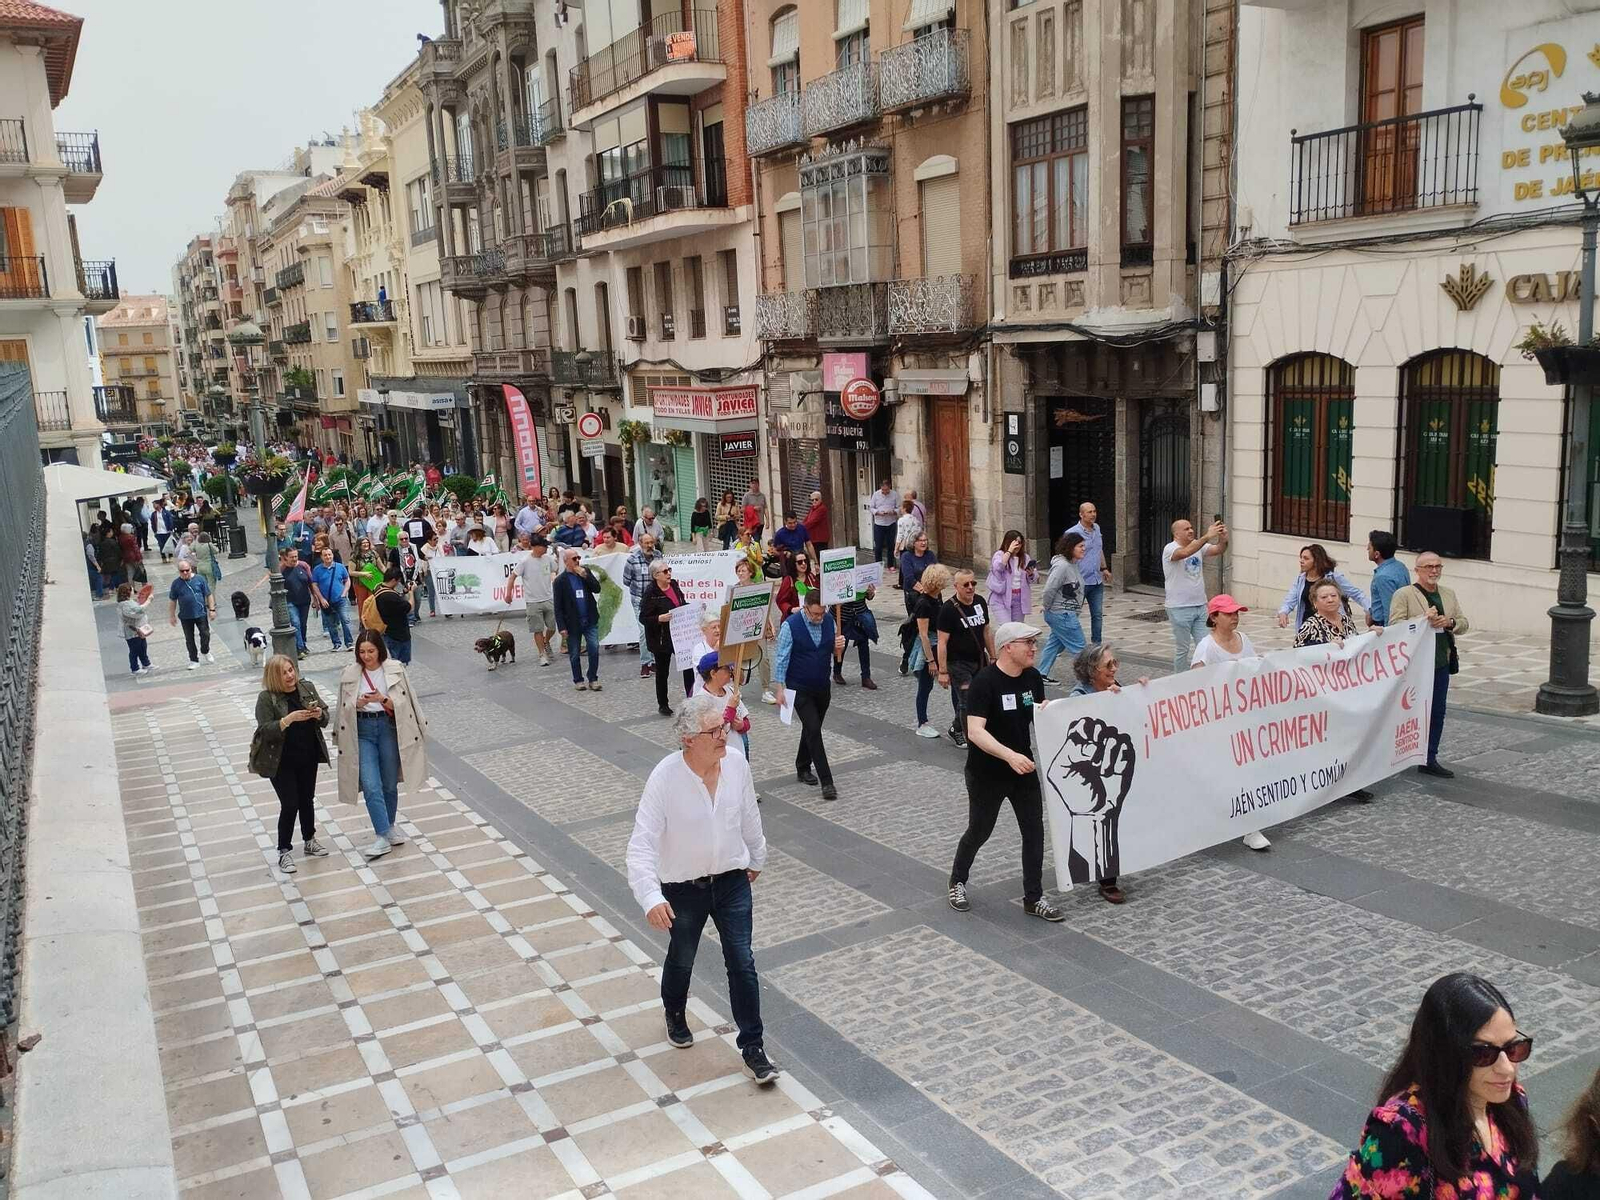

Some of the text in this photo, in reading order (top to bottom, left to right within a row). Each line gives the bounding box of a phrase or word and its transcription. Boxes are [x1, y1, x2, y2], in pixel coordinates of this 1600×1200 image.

[1502, 148, 1531, 169] DE
[1515, 180, 1543, 201] DE
[716, 391, 754, 401] OPORTUNIDADES
[848, 393, 877, 402] Mahou
[692, 395, 713, 417] JAVIER
[717, 399, 755, 411] JAVIER
[724, 440, 753, 450] JAVIER
[504, 563, 517, 578] DE
[698, 580, 710, 588] es
[714, 579, 724, 588] la
[700, 591, 717, 600] del
[1144, 641, 1410, 760] ¡VENDER LA SANIDAD PÚBLICA ES
[1230, 710, 1328, 767] UN CRIMEN!
[1395, 731, 1419, 749] SENTIDO
[1230, 758, 1347, 818] JAÉN SENTIDO Y COMÚN
